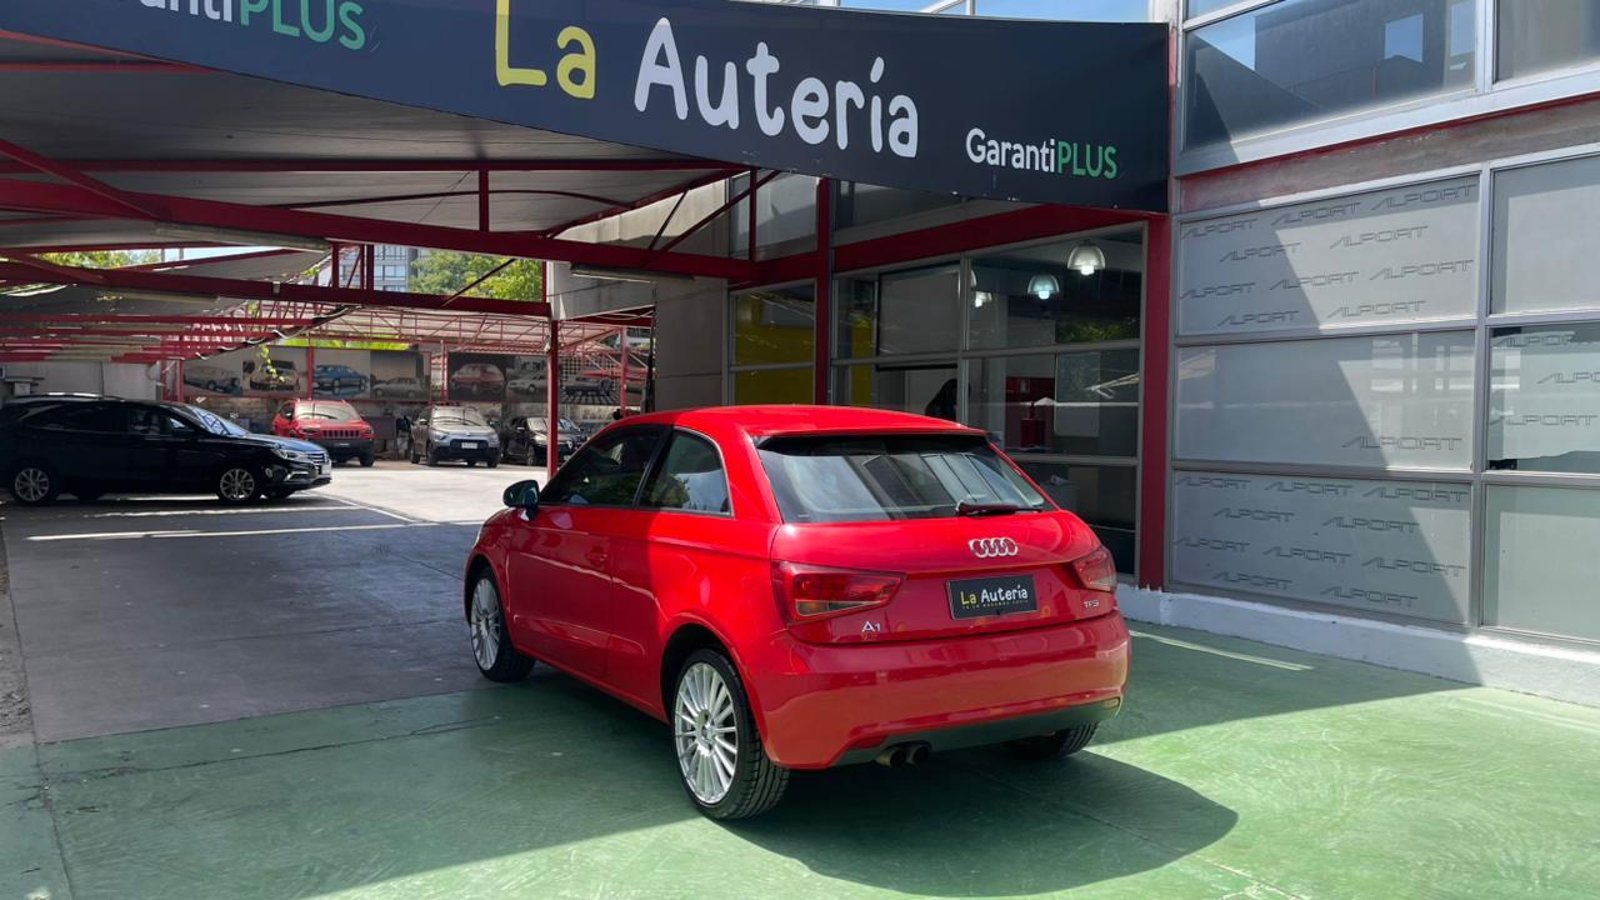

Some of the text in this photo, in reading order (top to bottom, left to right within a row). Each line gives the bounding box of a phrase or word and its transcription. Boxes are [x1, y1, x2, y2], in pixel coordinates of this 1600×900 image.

[494, 0, 920, 160] La Autería
[965, 127, 1119, 180] GarantiPLUS
[959, 591, 977, 605] La
[980, 584, 1029, 604] Autería
[861, 620, 881, 633] A1
